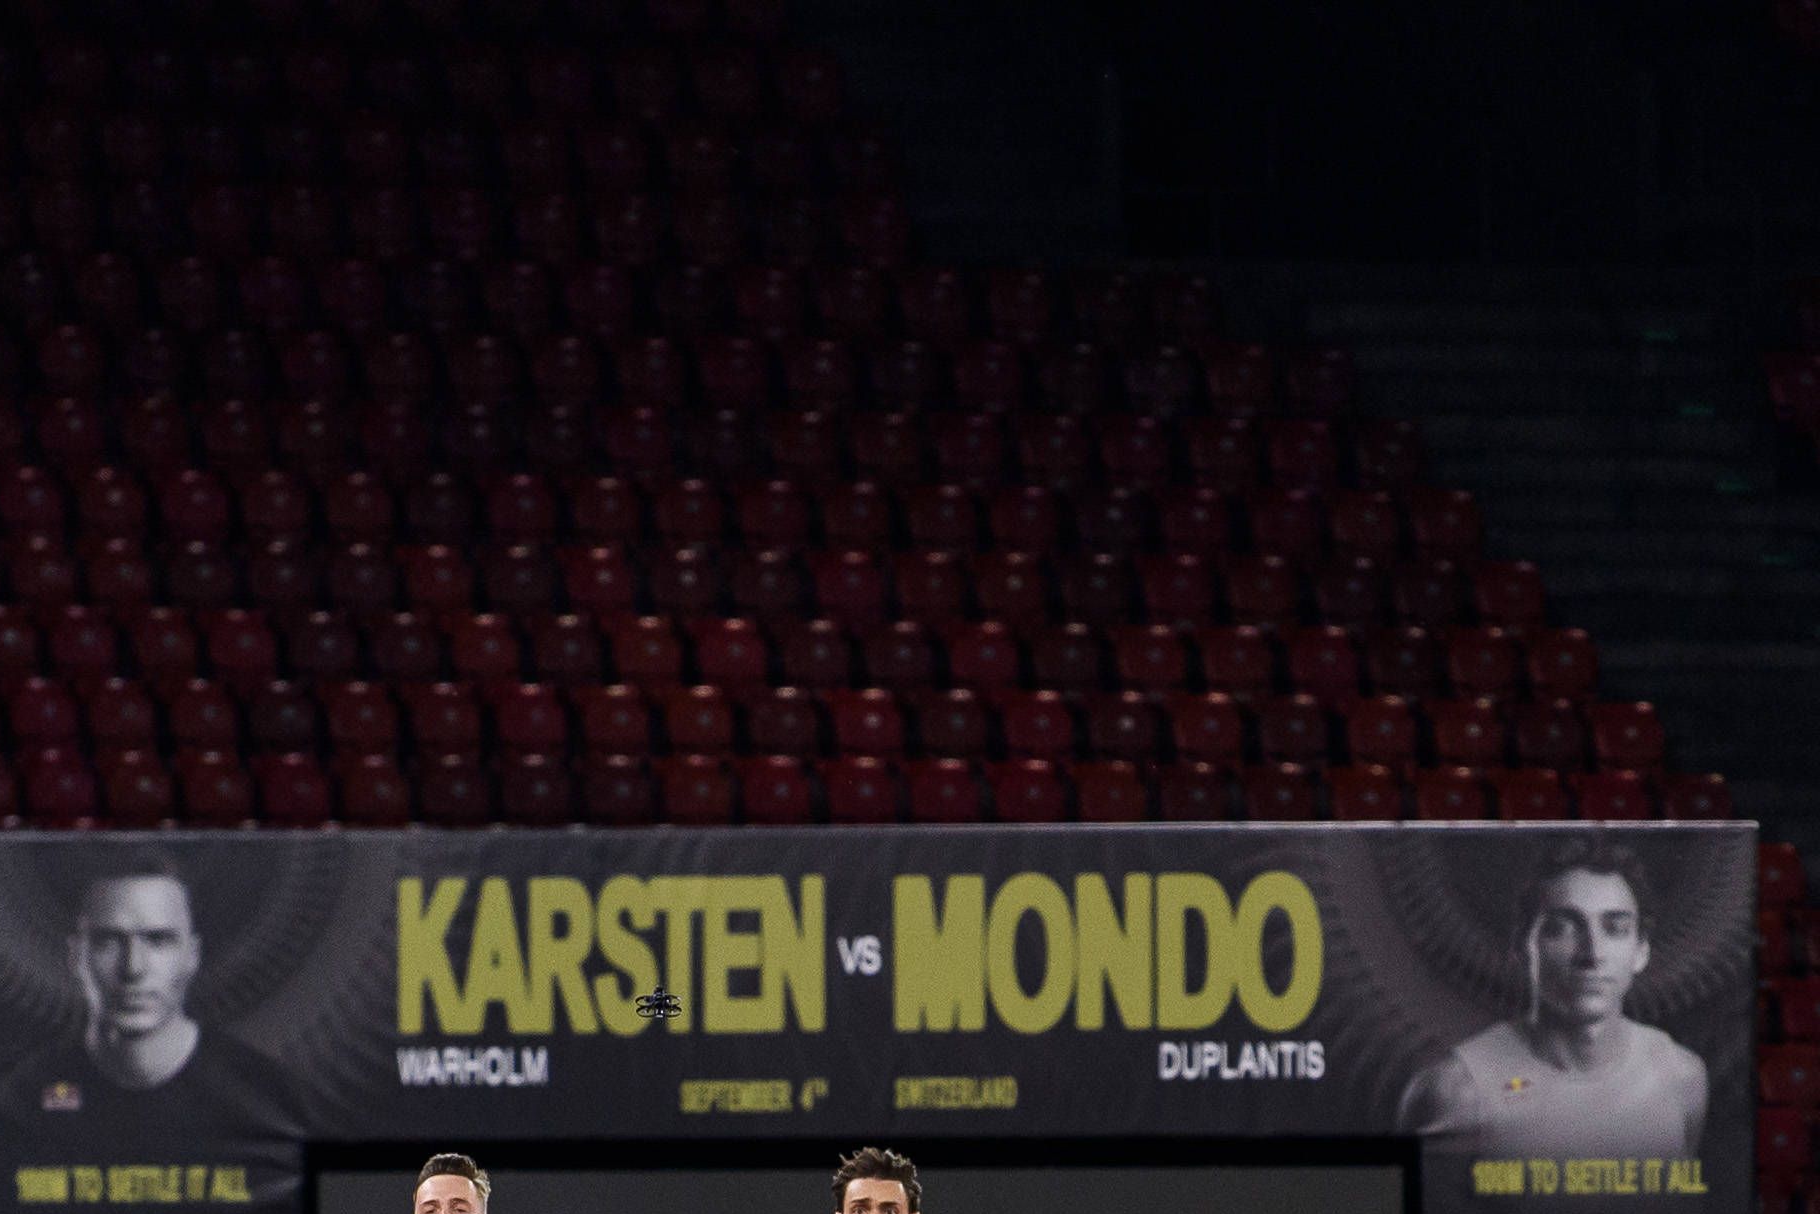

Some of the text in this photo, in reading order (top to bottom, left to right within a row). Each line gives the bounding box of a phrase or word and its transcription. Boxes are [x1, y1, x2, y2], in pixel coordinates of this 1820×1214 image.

[396, 871, 1325, 1036] KARSTEN VS MONDO
[395, 1046, 550, 1087] WARHOLM
[1157, 1041, 1326, 1081] DUPLANTIS
[1529, 1159, 1559, 1195] TO
[1564, 1158, 1640, 1195] SETTLE
[1643, 1158, 1665, 1195] IT
[1667, 1158, 1709, 1195] ALL
